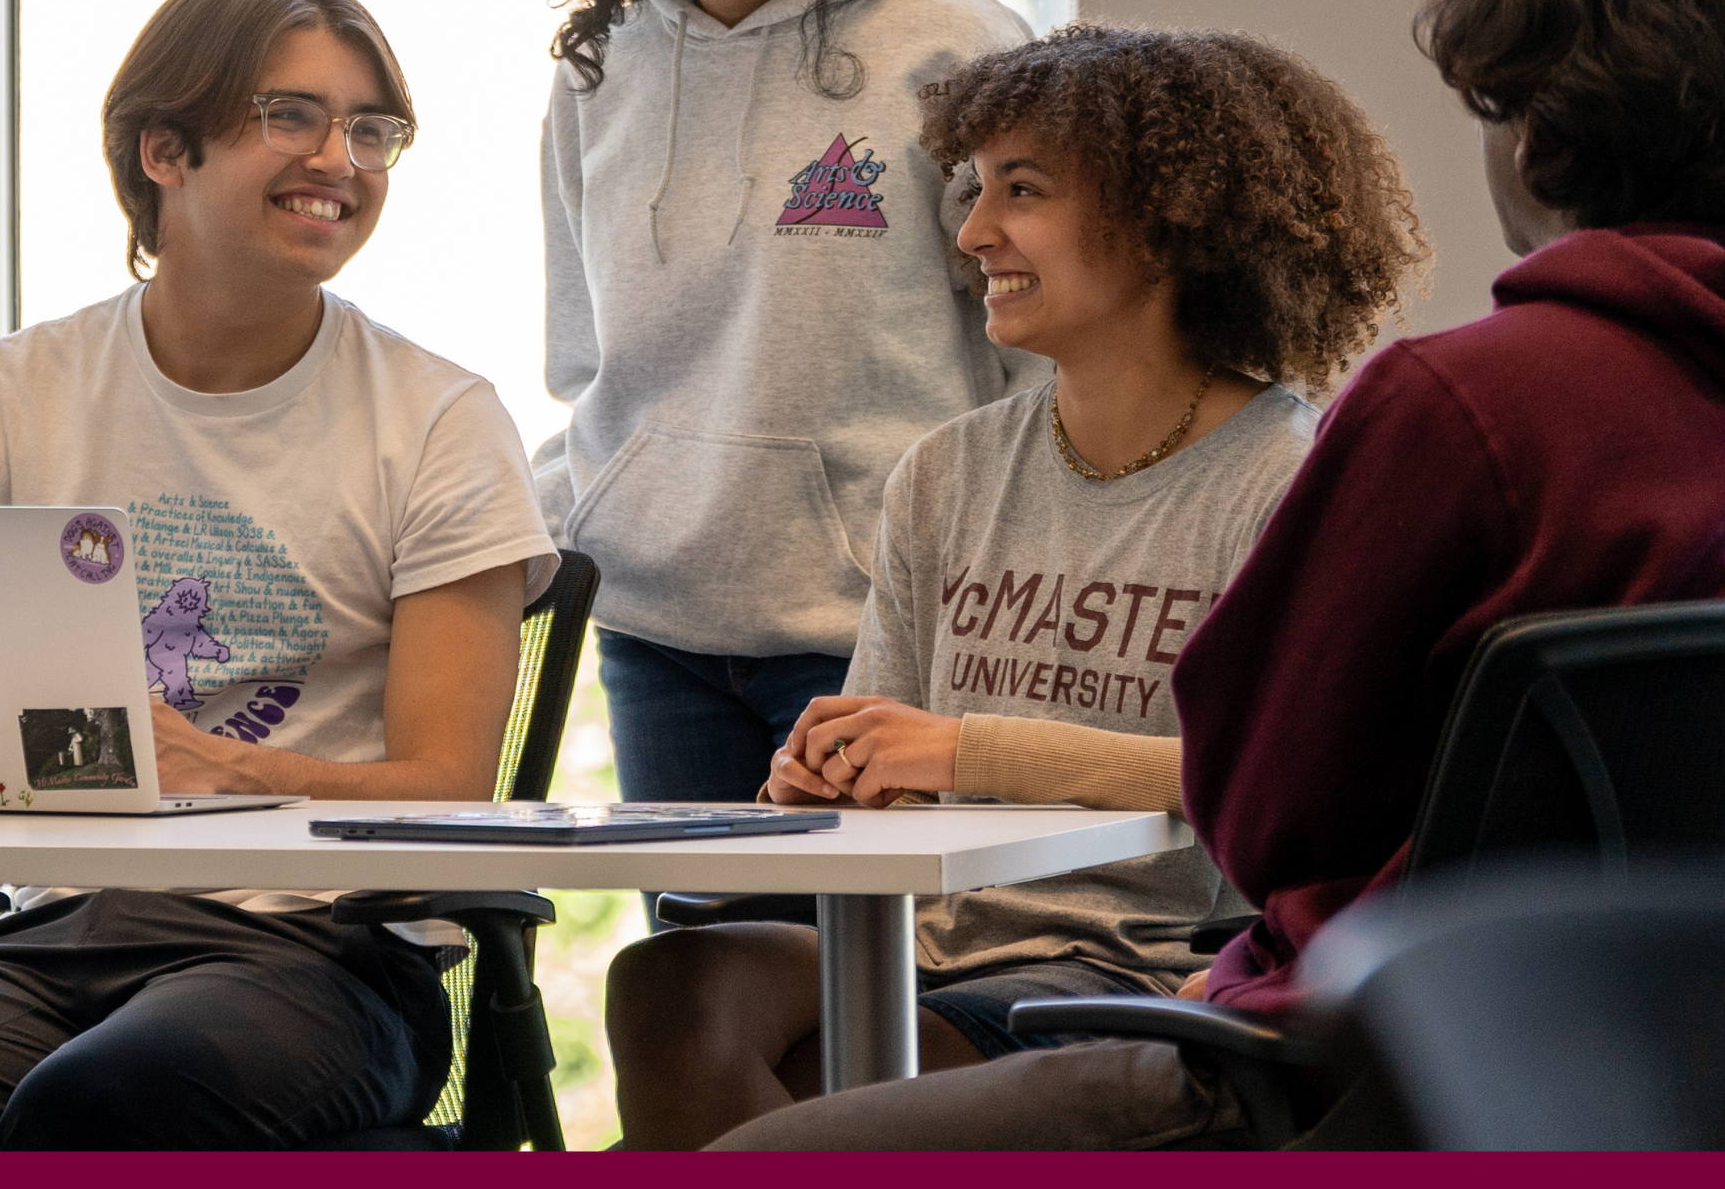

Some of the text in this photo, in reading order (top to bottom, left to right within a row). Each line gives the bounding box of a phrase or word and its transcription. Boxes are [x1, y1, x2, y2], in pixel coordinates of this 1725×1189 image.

[788, 148, 887, 187] Arts &
[783, 183, 884, 212] Science
[774, 227, 888, 239] MMXXII MMXXIV
[159, 492, 230, 510] Arts & Science
[140, 502, 194, 521] Practices
[195, 510, 205, 522] of
[207, 511, 253, 527] Knowledge
[136, 516, 180, 536] Melange
[193, 523, 208, 536] LR
[237, 526, 264, 539] 3038
[153, 532, 189, 549] Artsci
[190, 536, 224, 551] Musical
[235, 540, 275, 554] Calculus
[151, 550, 194, 563] overalls
[206, 552, 242, 568] Inquiry
[255, 554, 300, 569] SASSex
[176, 566, 195, 577] and
[197, 566, 231, 580] Cookies
[246, 568, 306, 585] Indigenous
[214, 581, 230, 593] Art
[234, 582, 261, 595] Show
[276, 587, 316, 599] nuance
[302, 598, 323, 611] fun
[240, 610, 269, 623] Pizza
[272, 611, 310, 627] Plunge
[234, 627, 276, 638] passion
[291, 628, 328, 642] Agora
[230, 635, 275, 650] Political
[280, 637, 328, 655] Thought
[260, 651, 310, 664] activism
[215, 663, 257, 679] Physics
[951, 652, 1161, 718] UNIVERSITY
